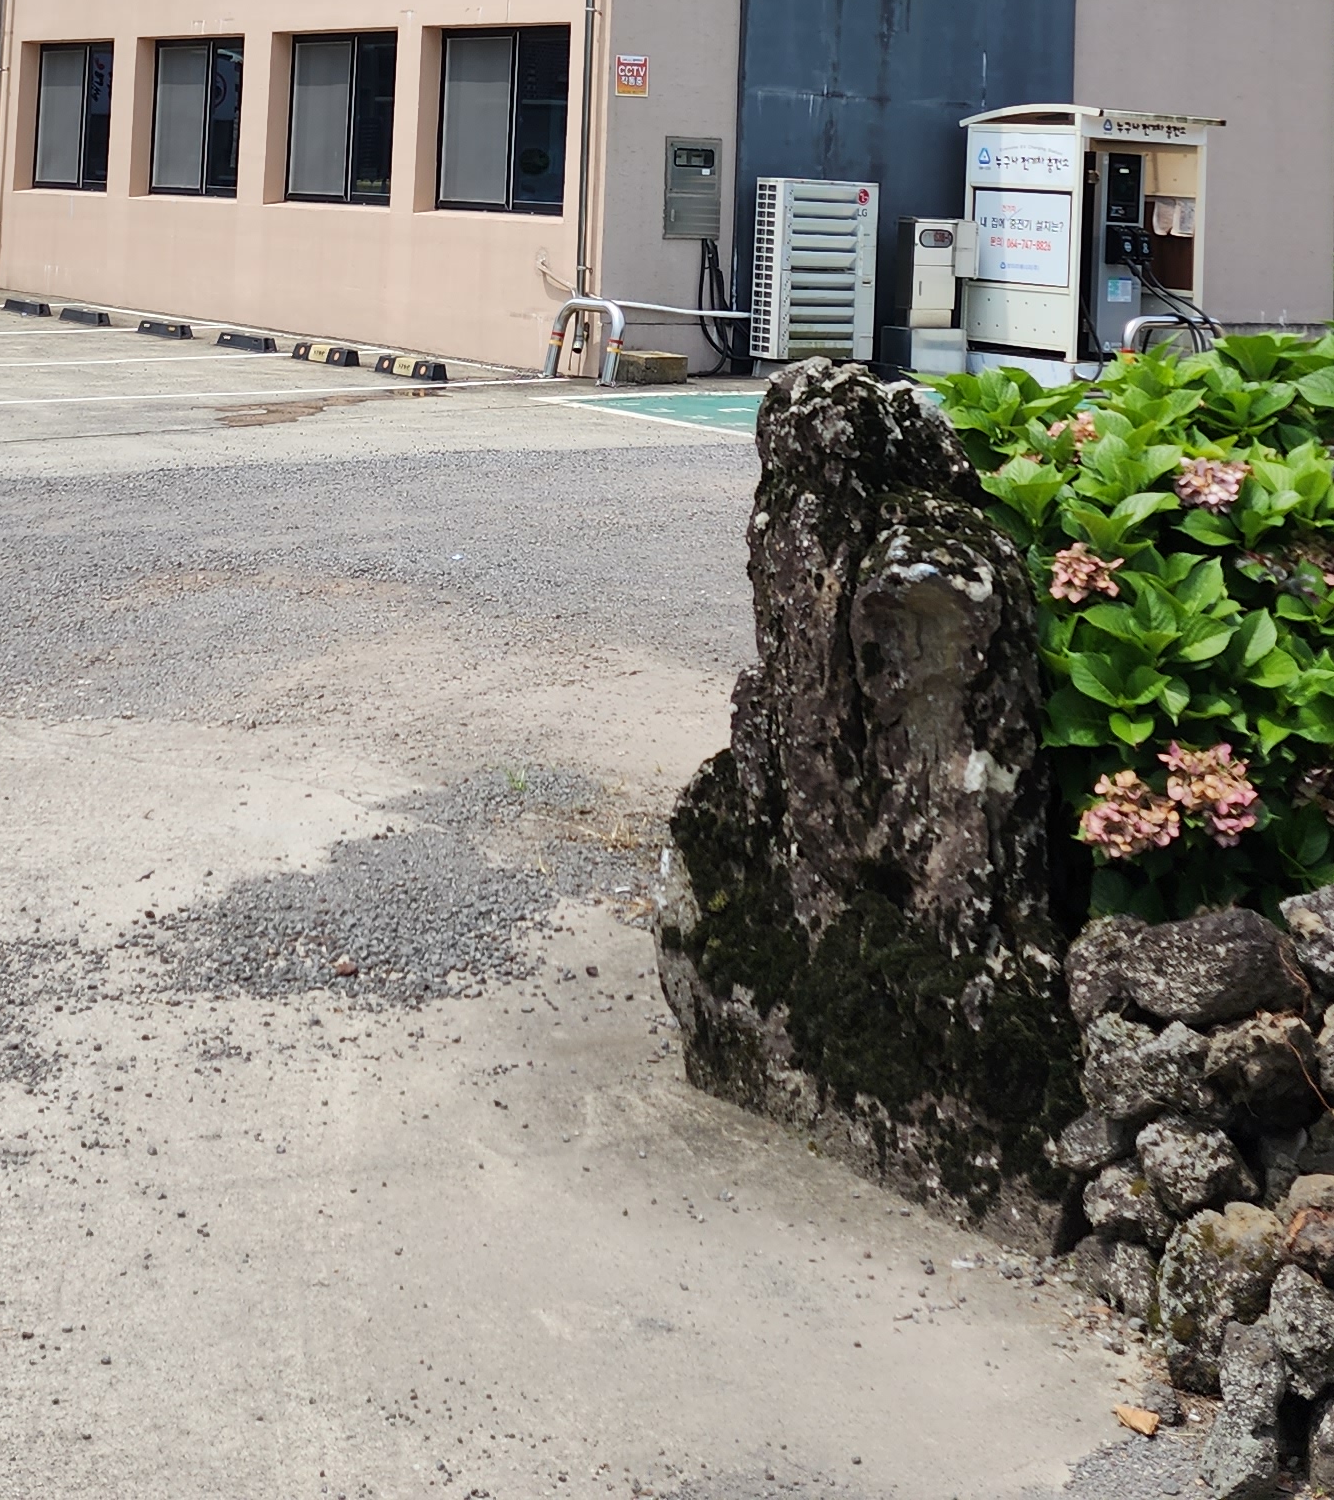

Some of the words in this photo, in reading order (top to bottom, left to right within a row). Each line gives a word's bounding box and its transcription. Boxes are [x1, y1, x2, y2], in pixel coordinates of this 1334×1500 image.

[618, 65, 646, 77] CCTV
[995, 155, 1019, 170] 누구나
[858, 208, 868, 217] LG
[980, 216, 987, 228] 내
[991, 217, 1005, 229] 집에
